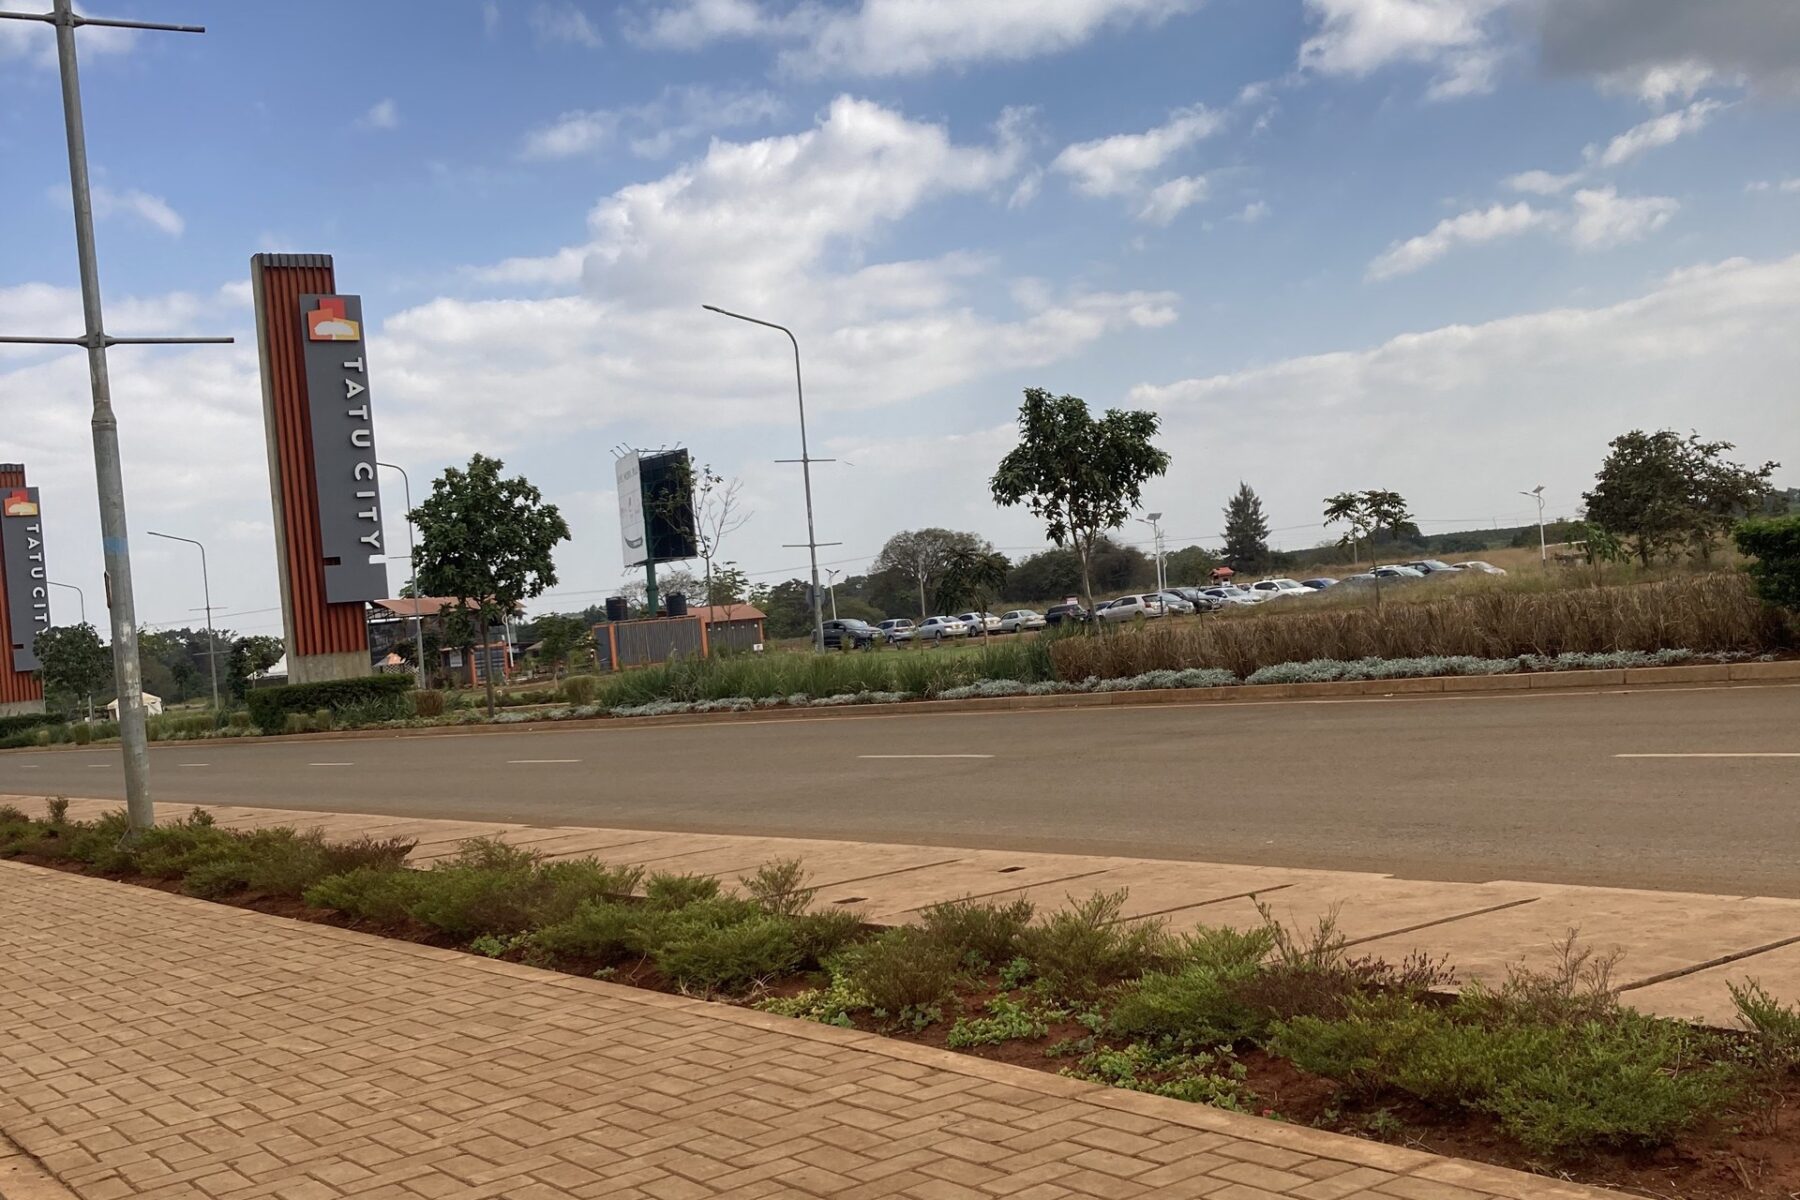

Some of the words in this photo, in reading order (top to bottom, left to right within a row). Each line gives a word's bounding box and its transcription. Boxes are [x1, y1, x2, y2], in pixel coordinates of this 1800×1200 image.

[343, 357, 371, 448] TATU
[354, 462, 380, 549] CITY
[26, 523, 44, 578] TATU
